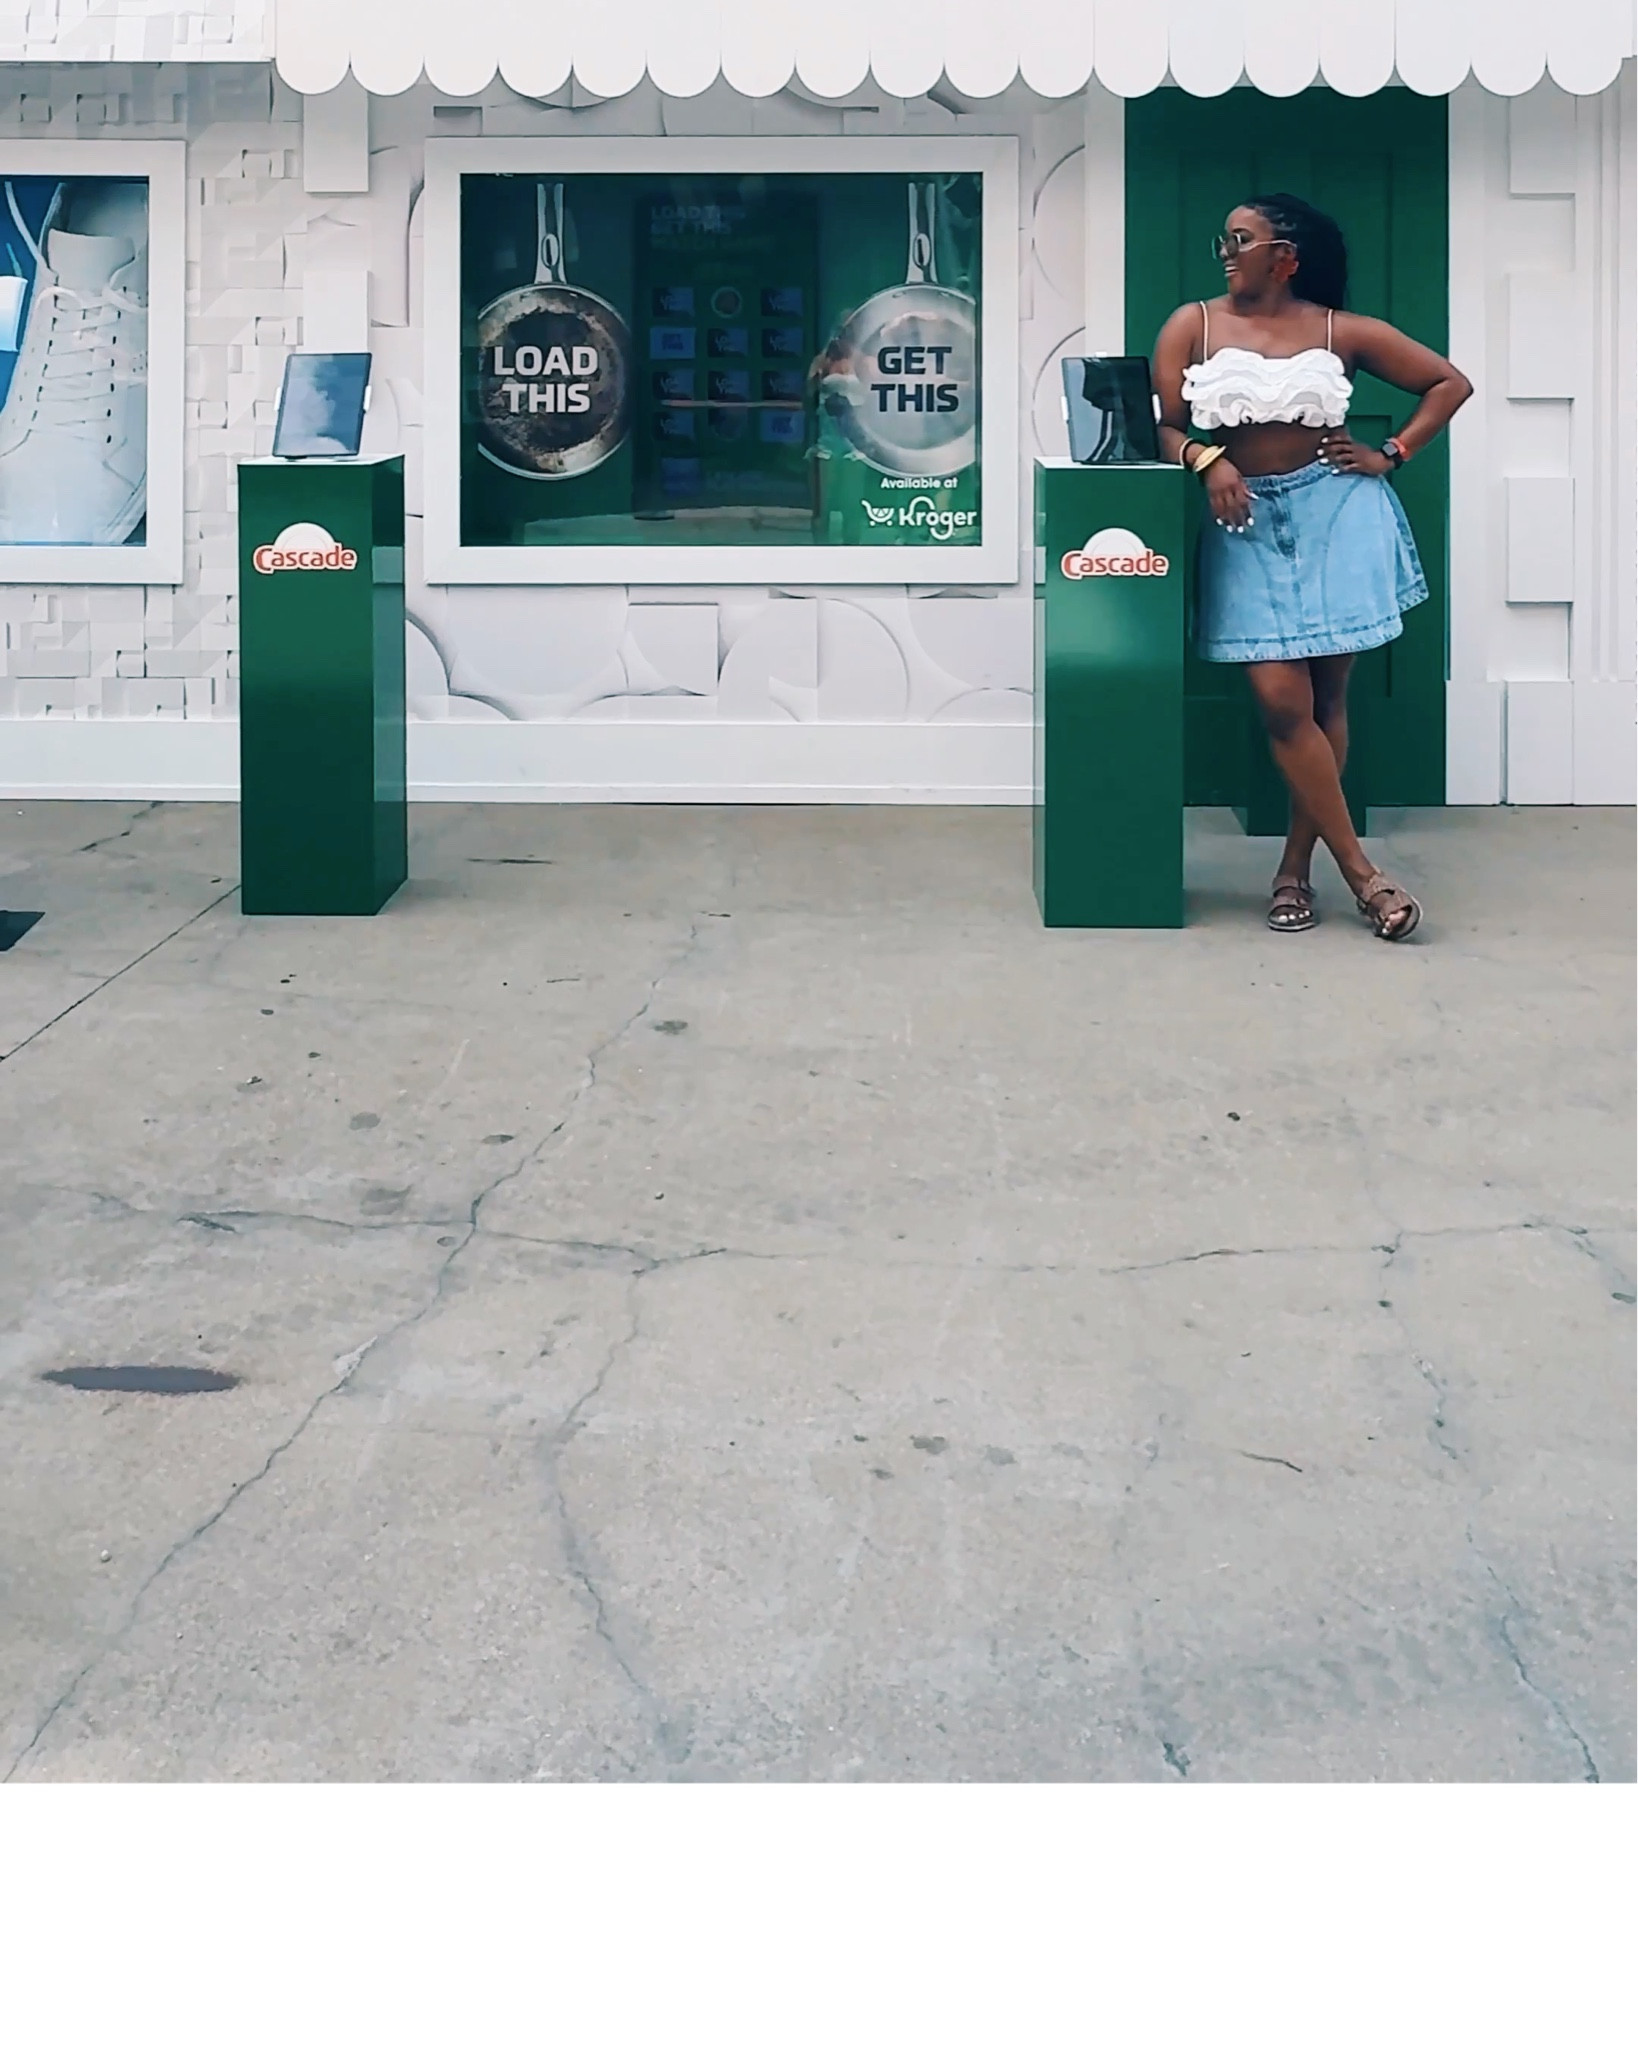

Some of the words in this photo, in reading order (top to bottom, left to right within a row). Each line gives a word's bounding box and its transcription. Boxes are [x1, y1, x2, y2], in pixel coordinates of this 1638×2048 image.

[494, 345, 598, 376] LOAD
[877, 346, 952, 375] GET
[502, 383, 591, 413] THIS
[870, 383, 959, 413] THIS
[881, 477, 941, 489] Available
[943, 477, 958, 489] at
[899, 496, 977, 540] Kroger
[255, 545, 355, 572] Cascade
[1063, 550, 1167, 577] Cascade
